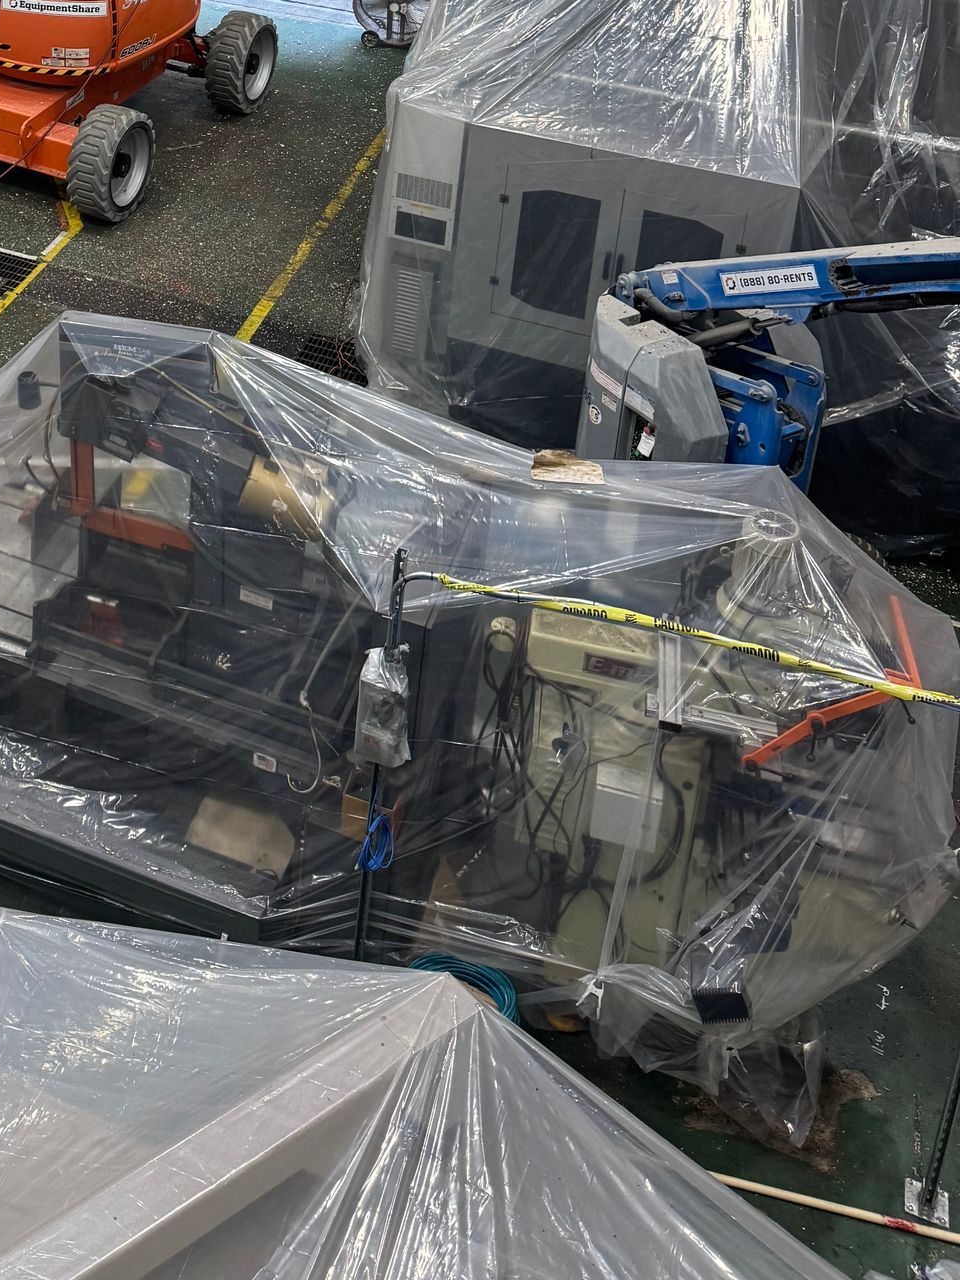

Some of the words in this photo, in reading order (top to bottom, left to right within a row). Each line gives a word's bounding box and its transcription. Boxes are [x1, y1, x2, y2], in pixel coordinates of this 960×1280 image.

[19, 0, 101, 13] EquipmentShare
[739, 275, 765, 288] (888)
[767, 271, 814, 285] 80-RENTS
